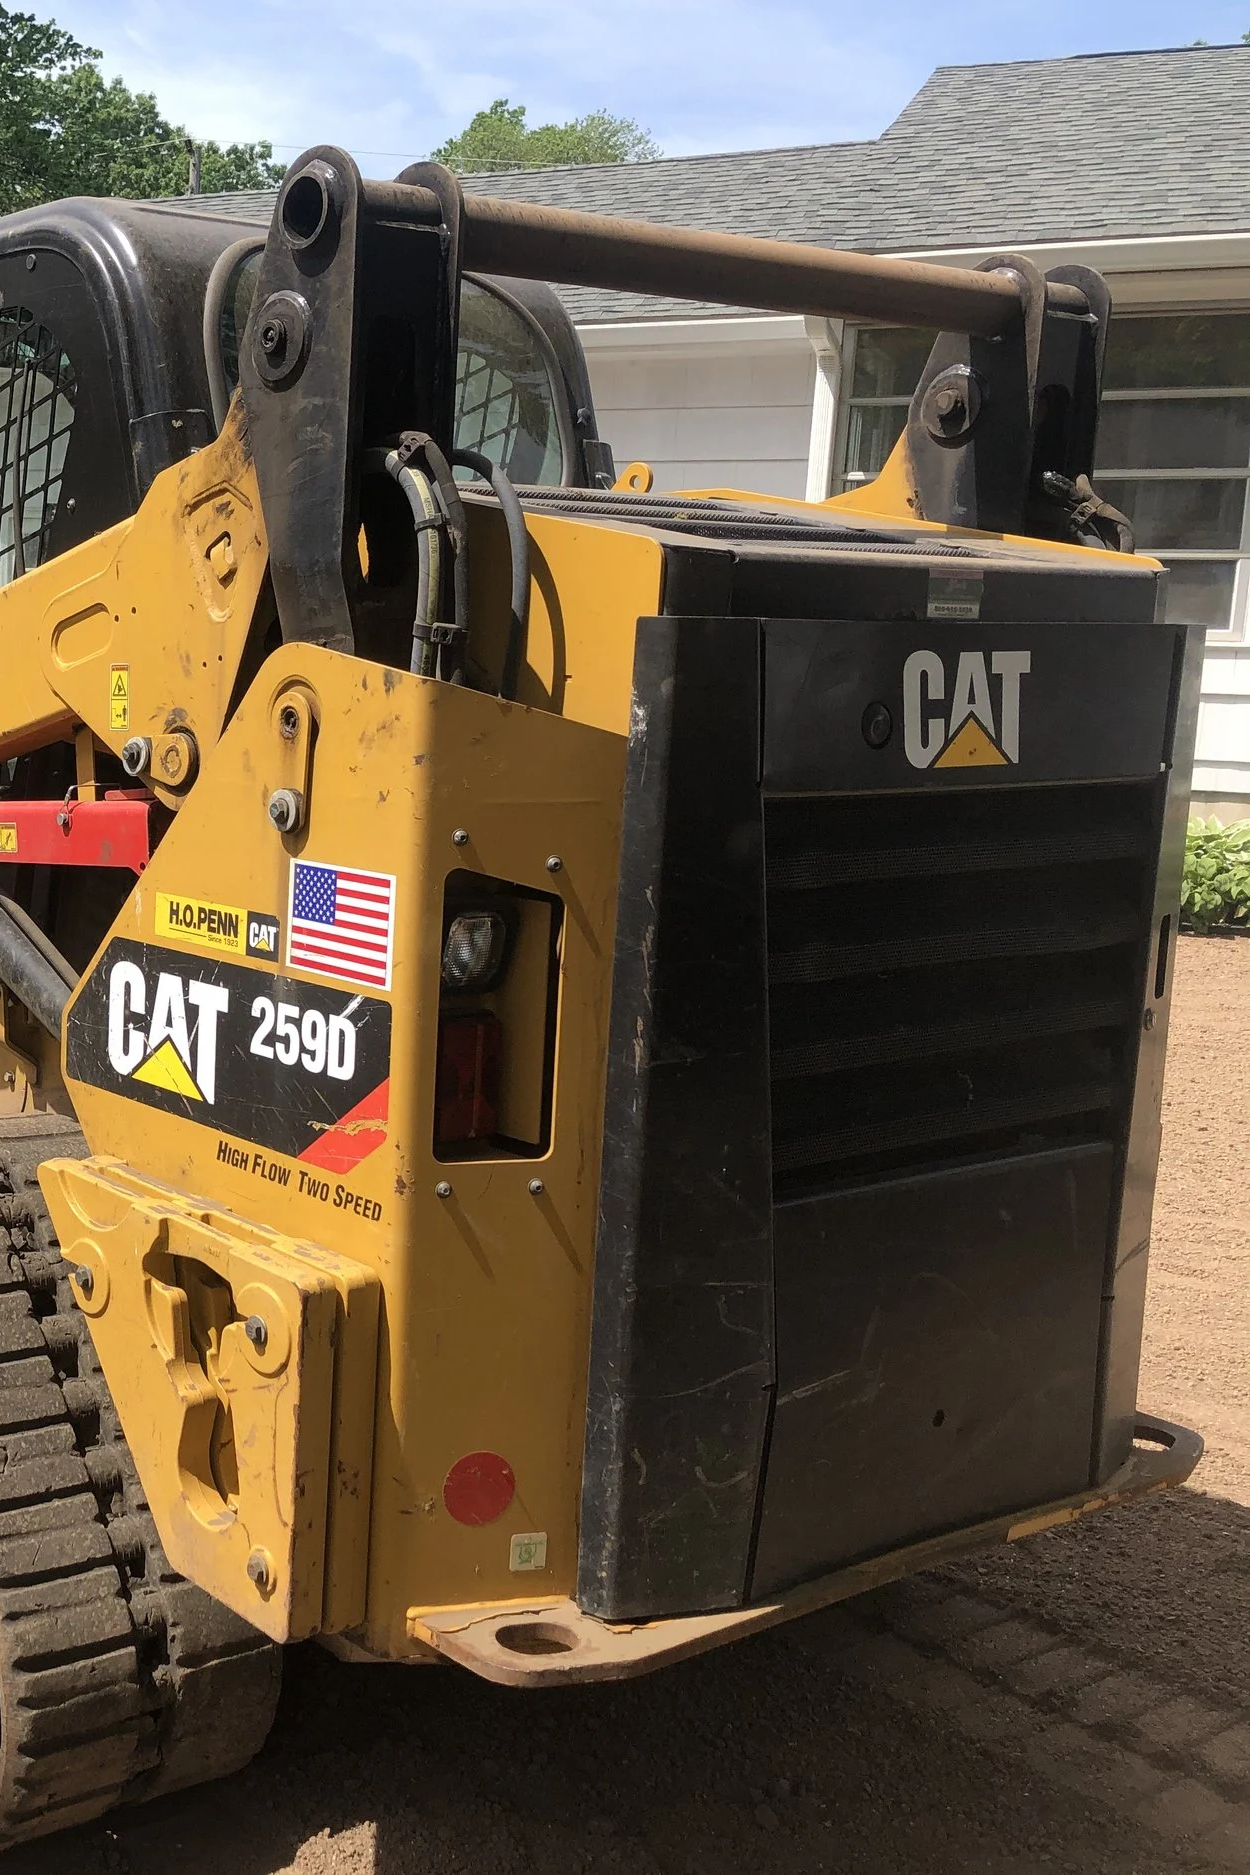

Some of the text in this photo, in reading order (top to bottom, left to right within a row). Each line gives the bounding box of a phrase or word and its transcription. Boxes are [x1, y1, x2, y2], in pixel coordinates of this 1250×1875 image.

[903, 650, 1031, 768] CAT
[169, 901, 239, 939] H.O.PENN
[207, 934, 239, 947] Since 1923
[249, 922, 278, 951] CAT
[108, 961, 357, 1105] CAT 259D
[217, 1140, 382, 1222] HIGH FLOW TWO SPEED
